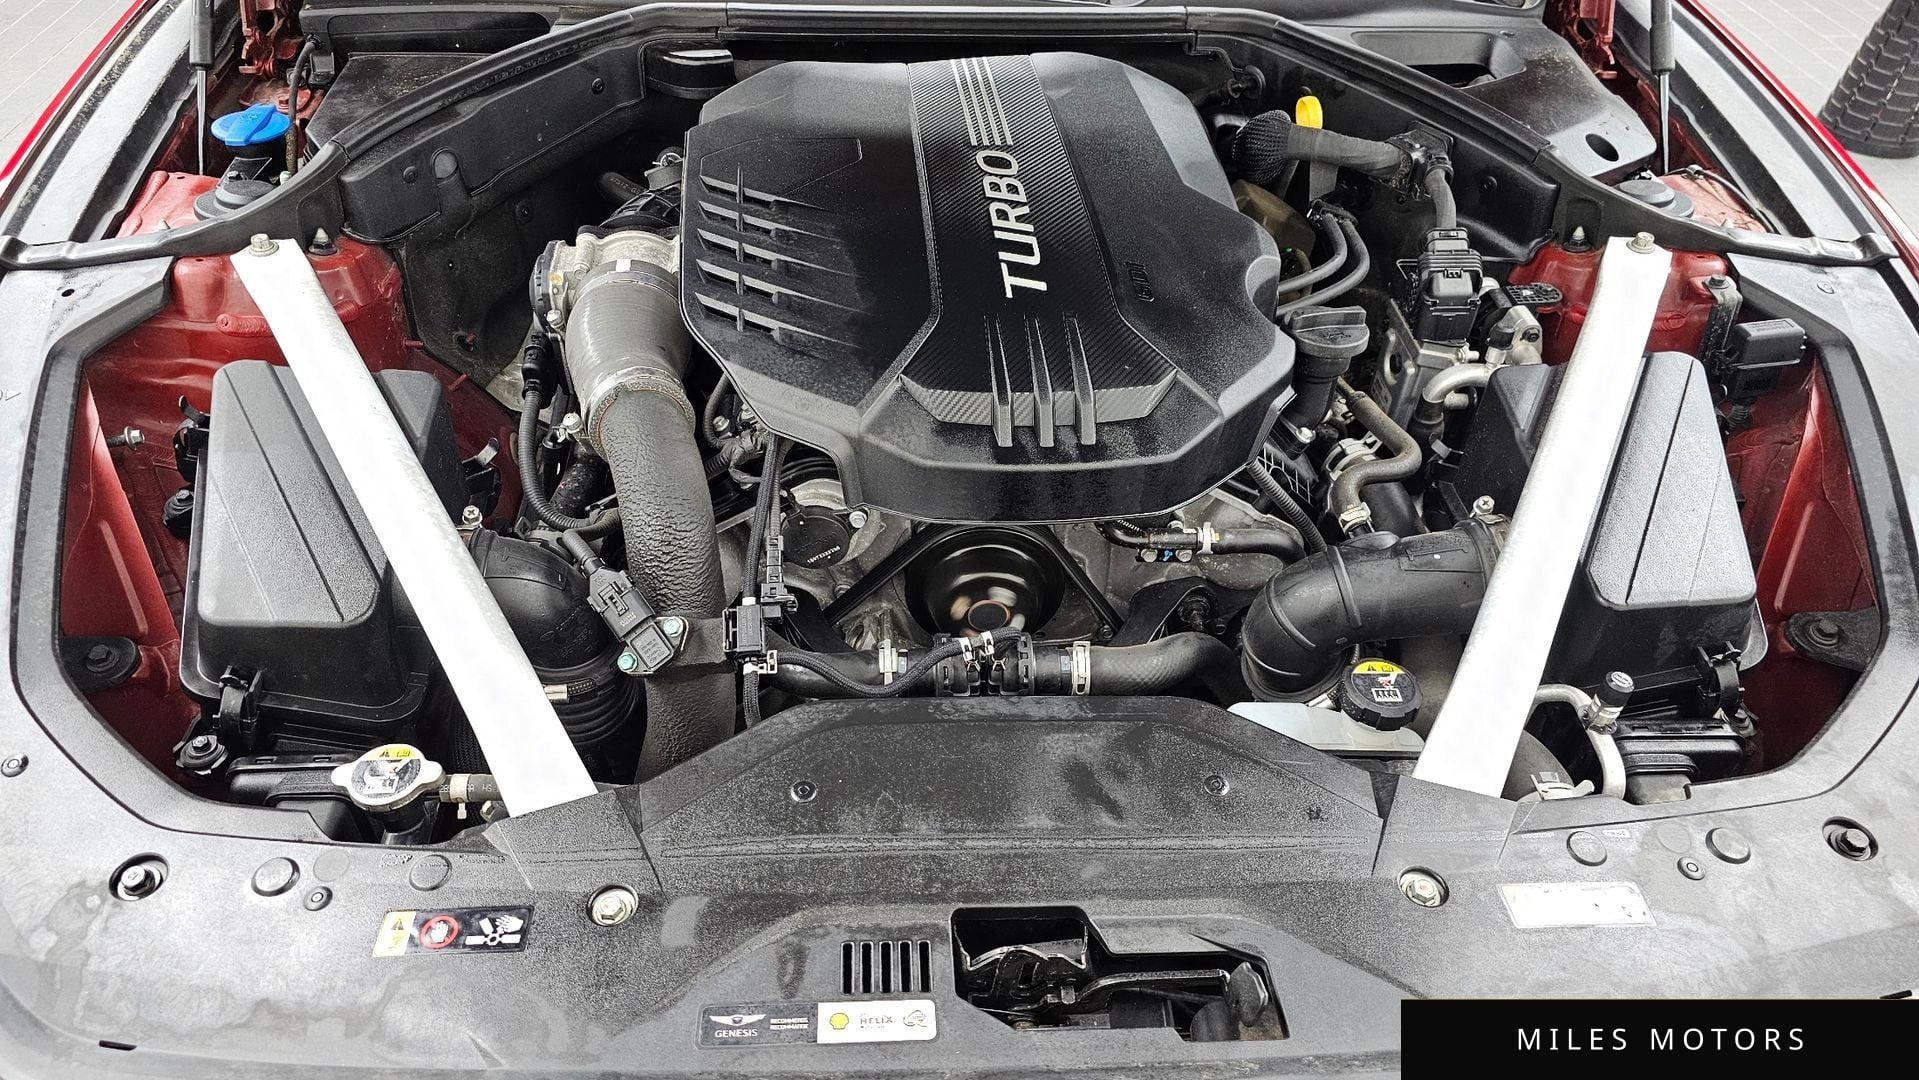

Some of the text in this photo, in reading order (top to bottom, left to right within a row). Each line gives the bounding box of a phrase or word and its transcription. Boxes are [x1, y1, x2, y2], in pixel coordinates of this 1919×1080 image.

[976, 150, 1048, 299] TURBO
[860, 1014, 893, 1025] HELIX
[715, 1028, 758, 1038] GENESIS
